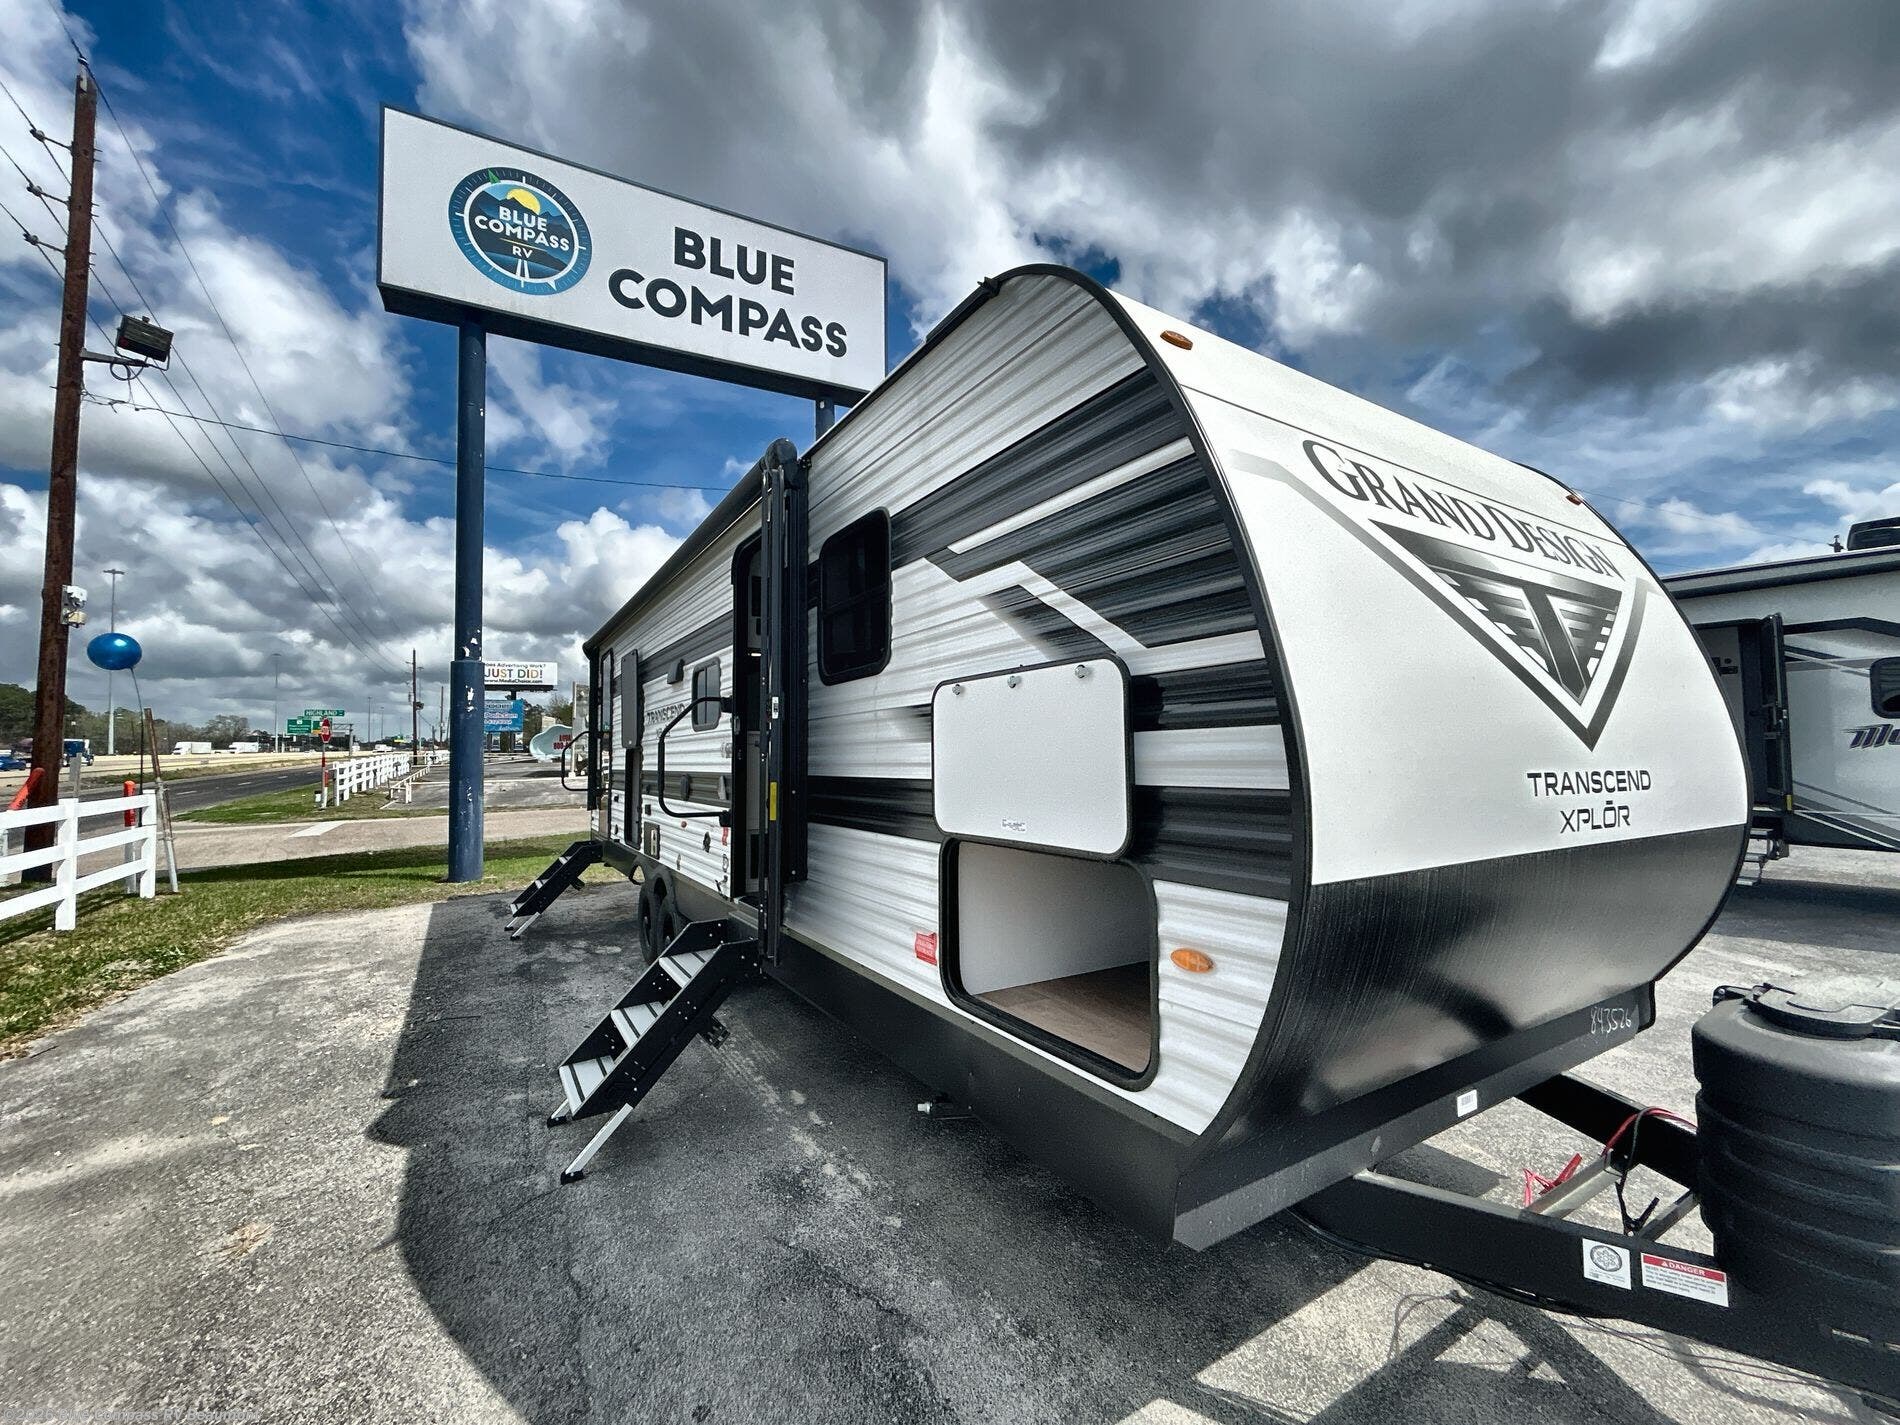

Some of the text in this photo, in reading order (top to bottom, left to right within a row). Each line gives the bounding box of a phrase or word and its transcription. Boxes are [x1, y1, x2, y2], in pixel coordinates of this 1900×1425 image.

[474, 214, 570, 252] COMPASS
[498, 205, 548, 233] BLUE
[511, 244, 534, 260] RV
[674, 226, 795, 296] BLUE
[608, 267, 848, 358] COMPASS
[1301, 439, 1626, 582] GRAND DESIGN
[484, 668, 543, 678] JUST DID!
[1527, 769, 1651, 798] TRANSCEND
[1590, 1006, 1632, 1035] 843526
[1668, 1261, 1706, 1277] DANGER
